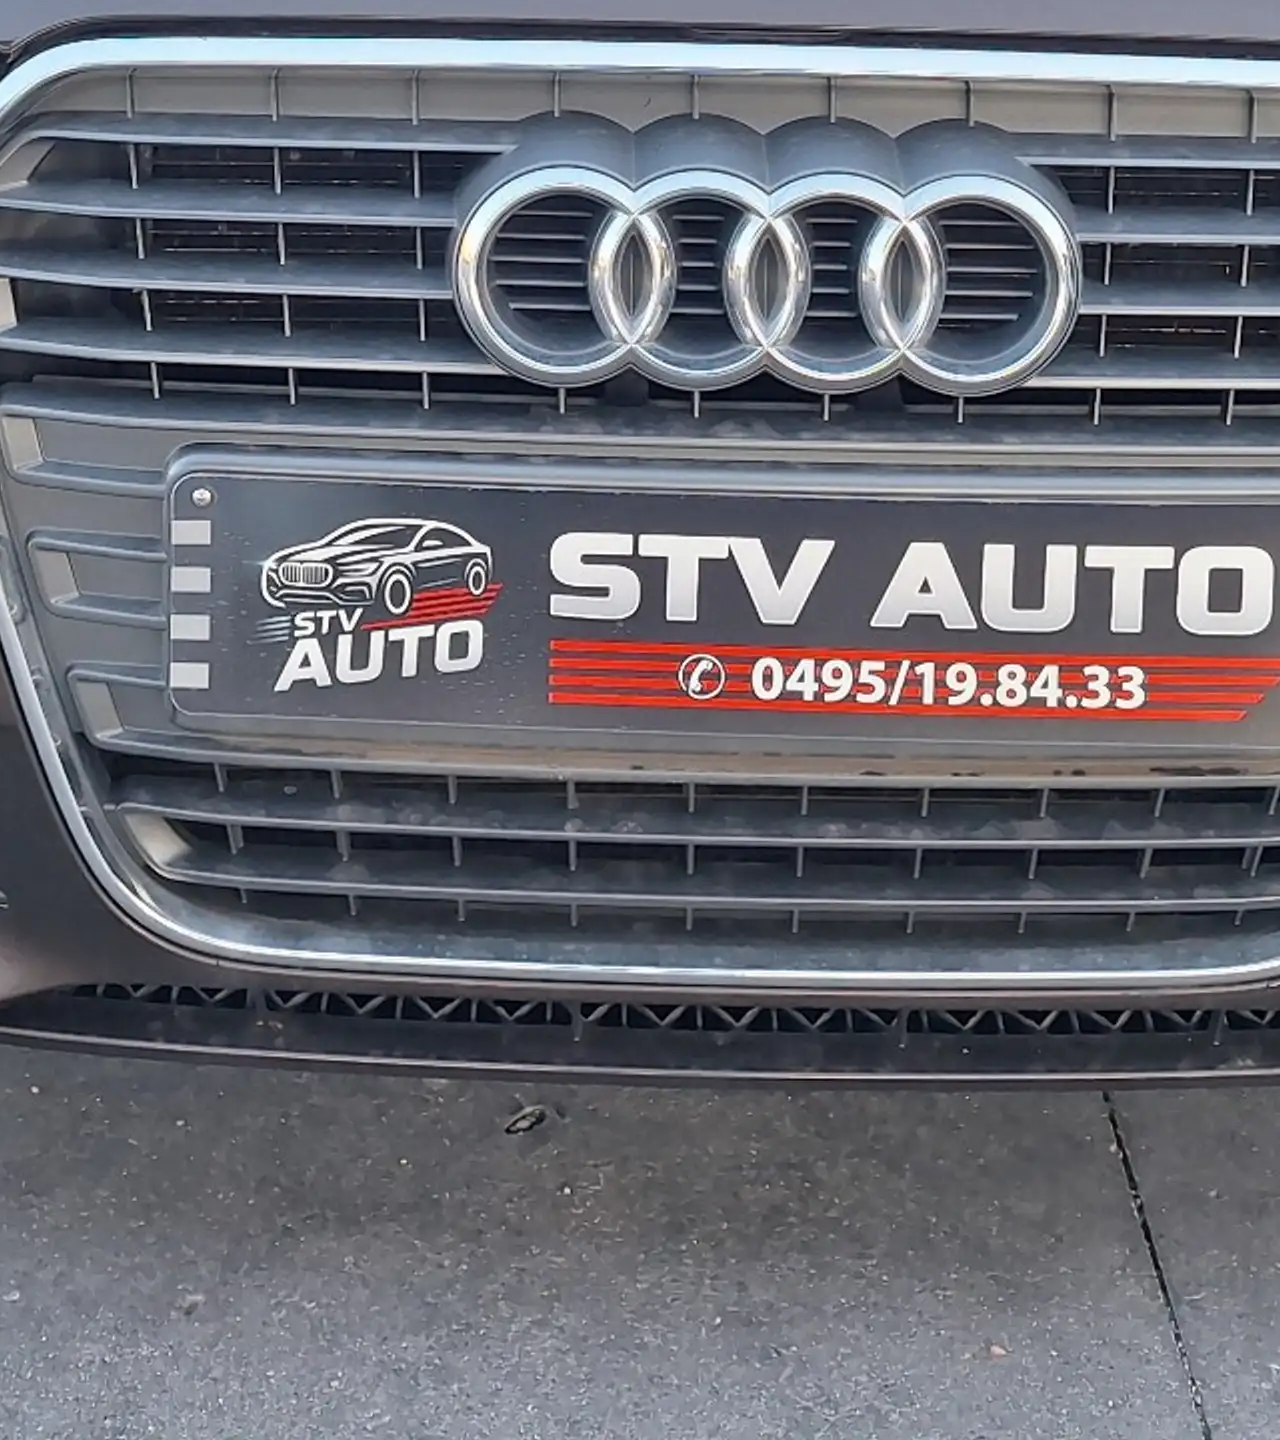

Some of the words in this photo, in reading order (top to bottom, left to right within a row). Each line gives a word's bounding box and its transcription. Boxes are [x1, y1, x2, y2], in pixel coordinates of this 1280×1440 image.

[549, 532, 837, 626] STV
[870, 541, 1275, 637] AUTO
[294, 608, 364, 637] STV
[274, 619, 484, 692] AUTO
[751, 656, 1146, 710] 0495/19.84.33
